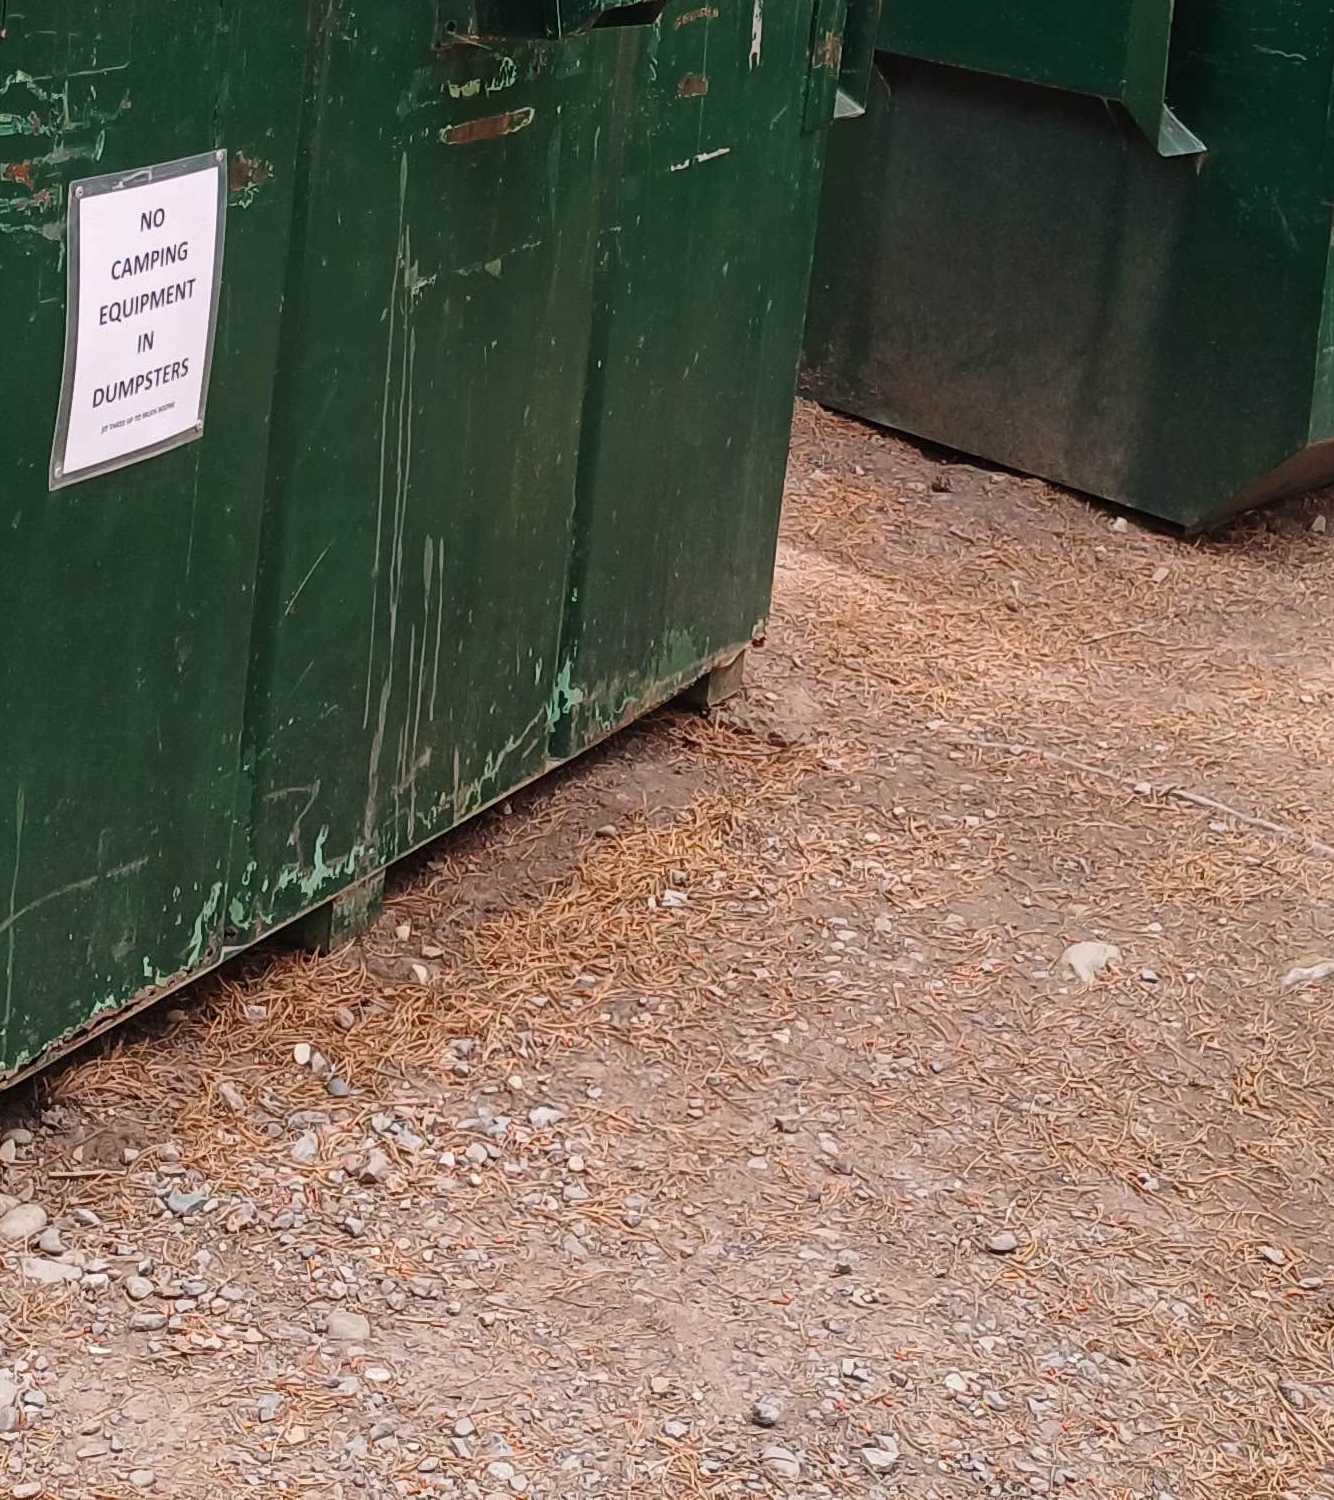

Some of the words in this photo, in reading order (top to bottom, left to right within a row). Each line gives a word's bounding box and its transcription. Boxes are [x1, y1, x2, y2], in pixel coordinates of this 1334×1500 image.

[140, 207, 165, 232] NO
[111, 241, 189, 281] CAMPING
[98, 278, 197, 326] EQUIPMENT
[137, 330, 155, 353] IN
[92, 357, 189, 409] DUMPSTERS
